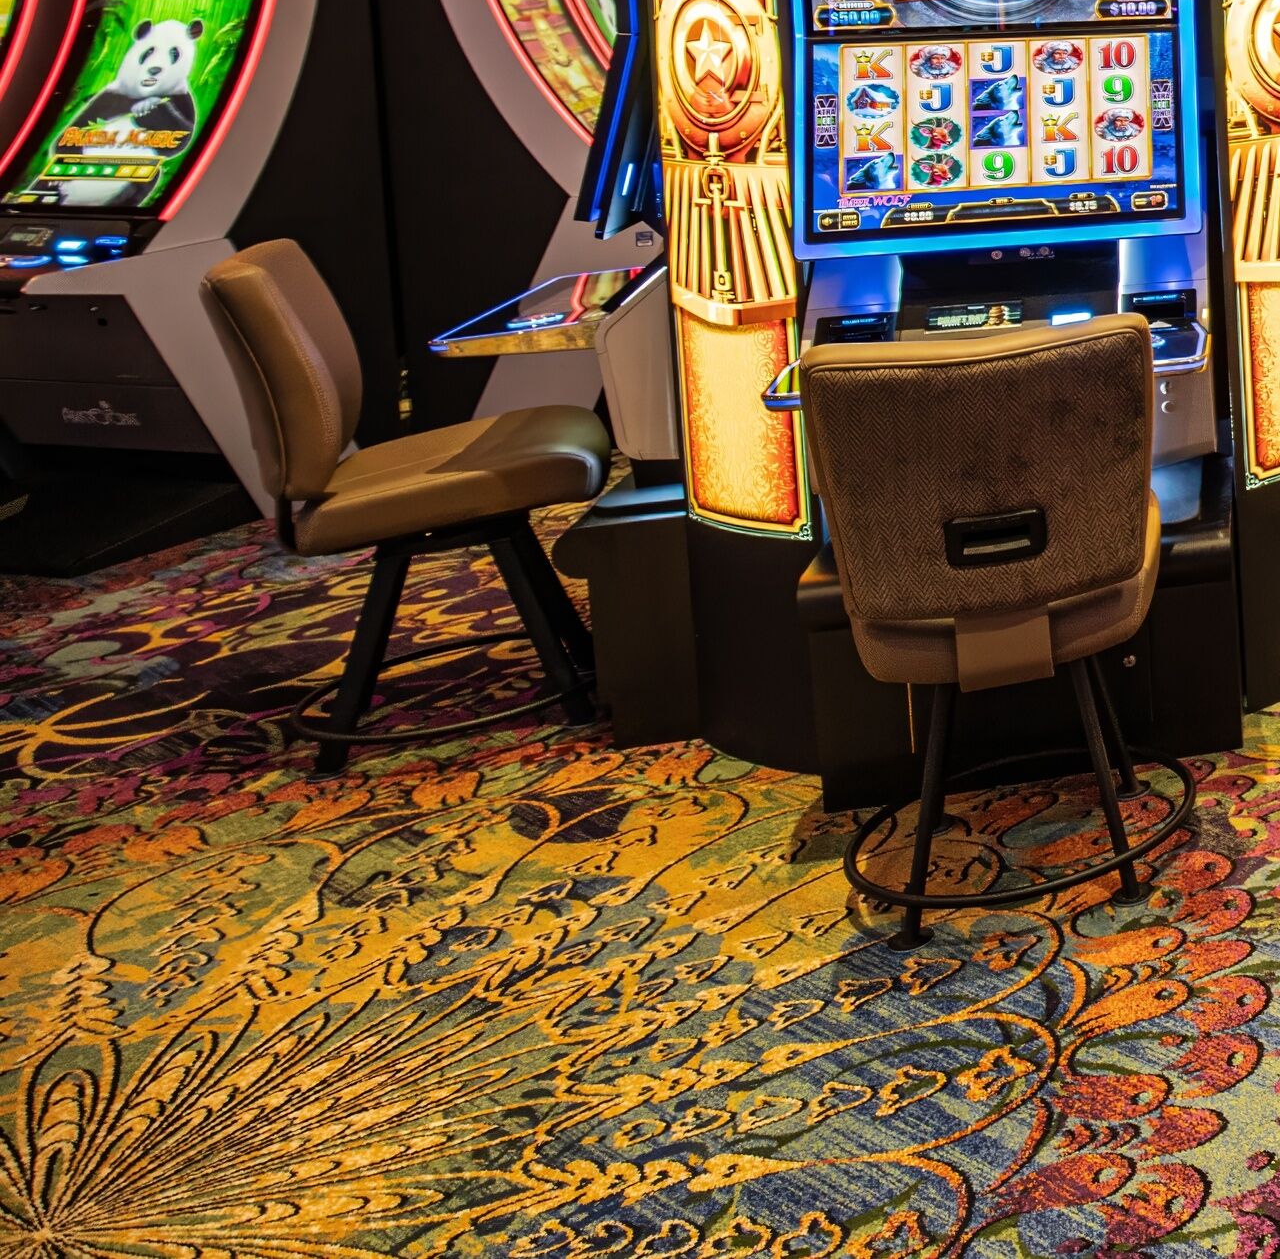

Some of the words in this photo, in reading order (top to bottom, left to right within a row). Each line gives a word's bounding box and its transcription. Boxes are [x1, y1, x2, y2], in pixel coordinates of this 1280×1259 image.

[830, 10, 880, 26] $50.00
[1110, 1, 1157, 16] $10.00
[1098, 41, 1137, 70] 10
[1102, 74, 1135, 104] 9
[981, 151, 1016, 182] 9
[1100, 145, 1139, 176] 10
[873, 194, 913, 207] WOLF
